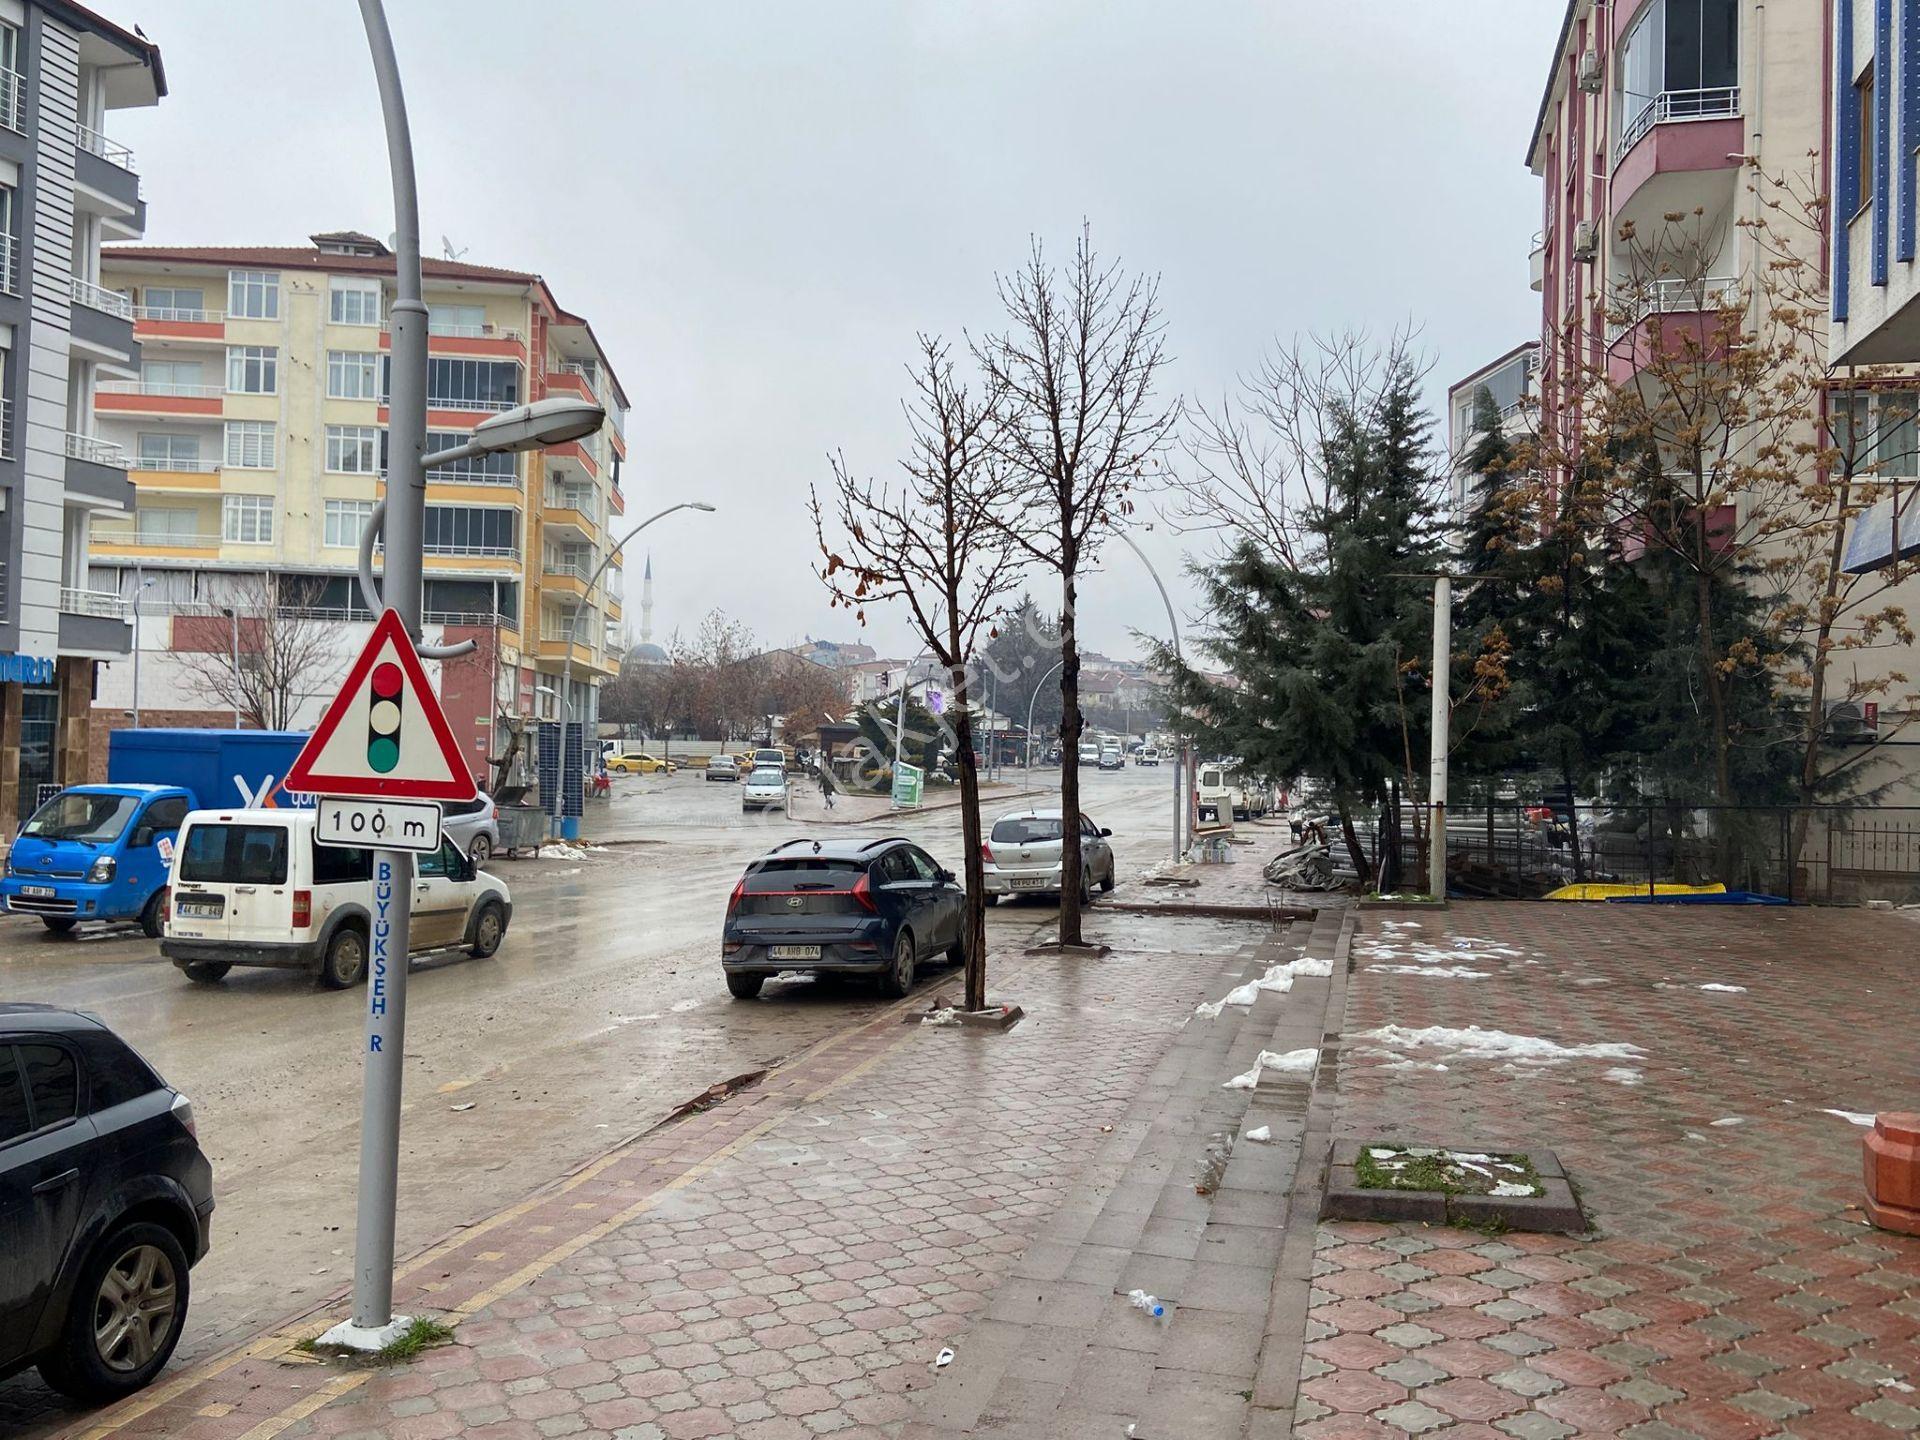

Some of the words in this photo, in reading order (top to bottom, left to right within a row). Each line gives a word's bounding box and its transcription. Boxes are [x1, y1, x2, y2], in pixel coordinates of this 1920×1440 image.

[333, 811, 385, 834] 100
[404, 821, 424, 837] m
[370, 862, 391, 1052] BÜYÜKŞEHR
[773, 946, 782, 956] 44
[805, 946, 820, 956] 074
